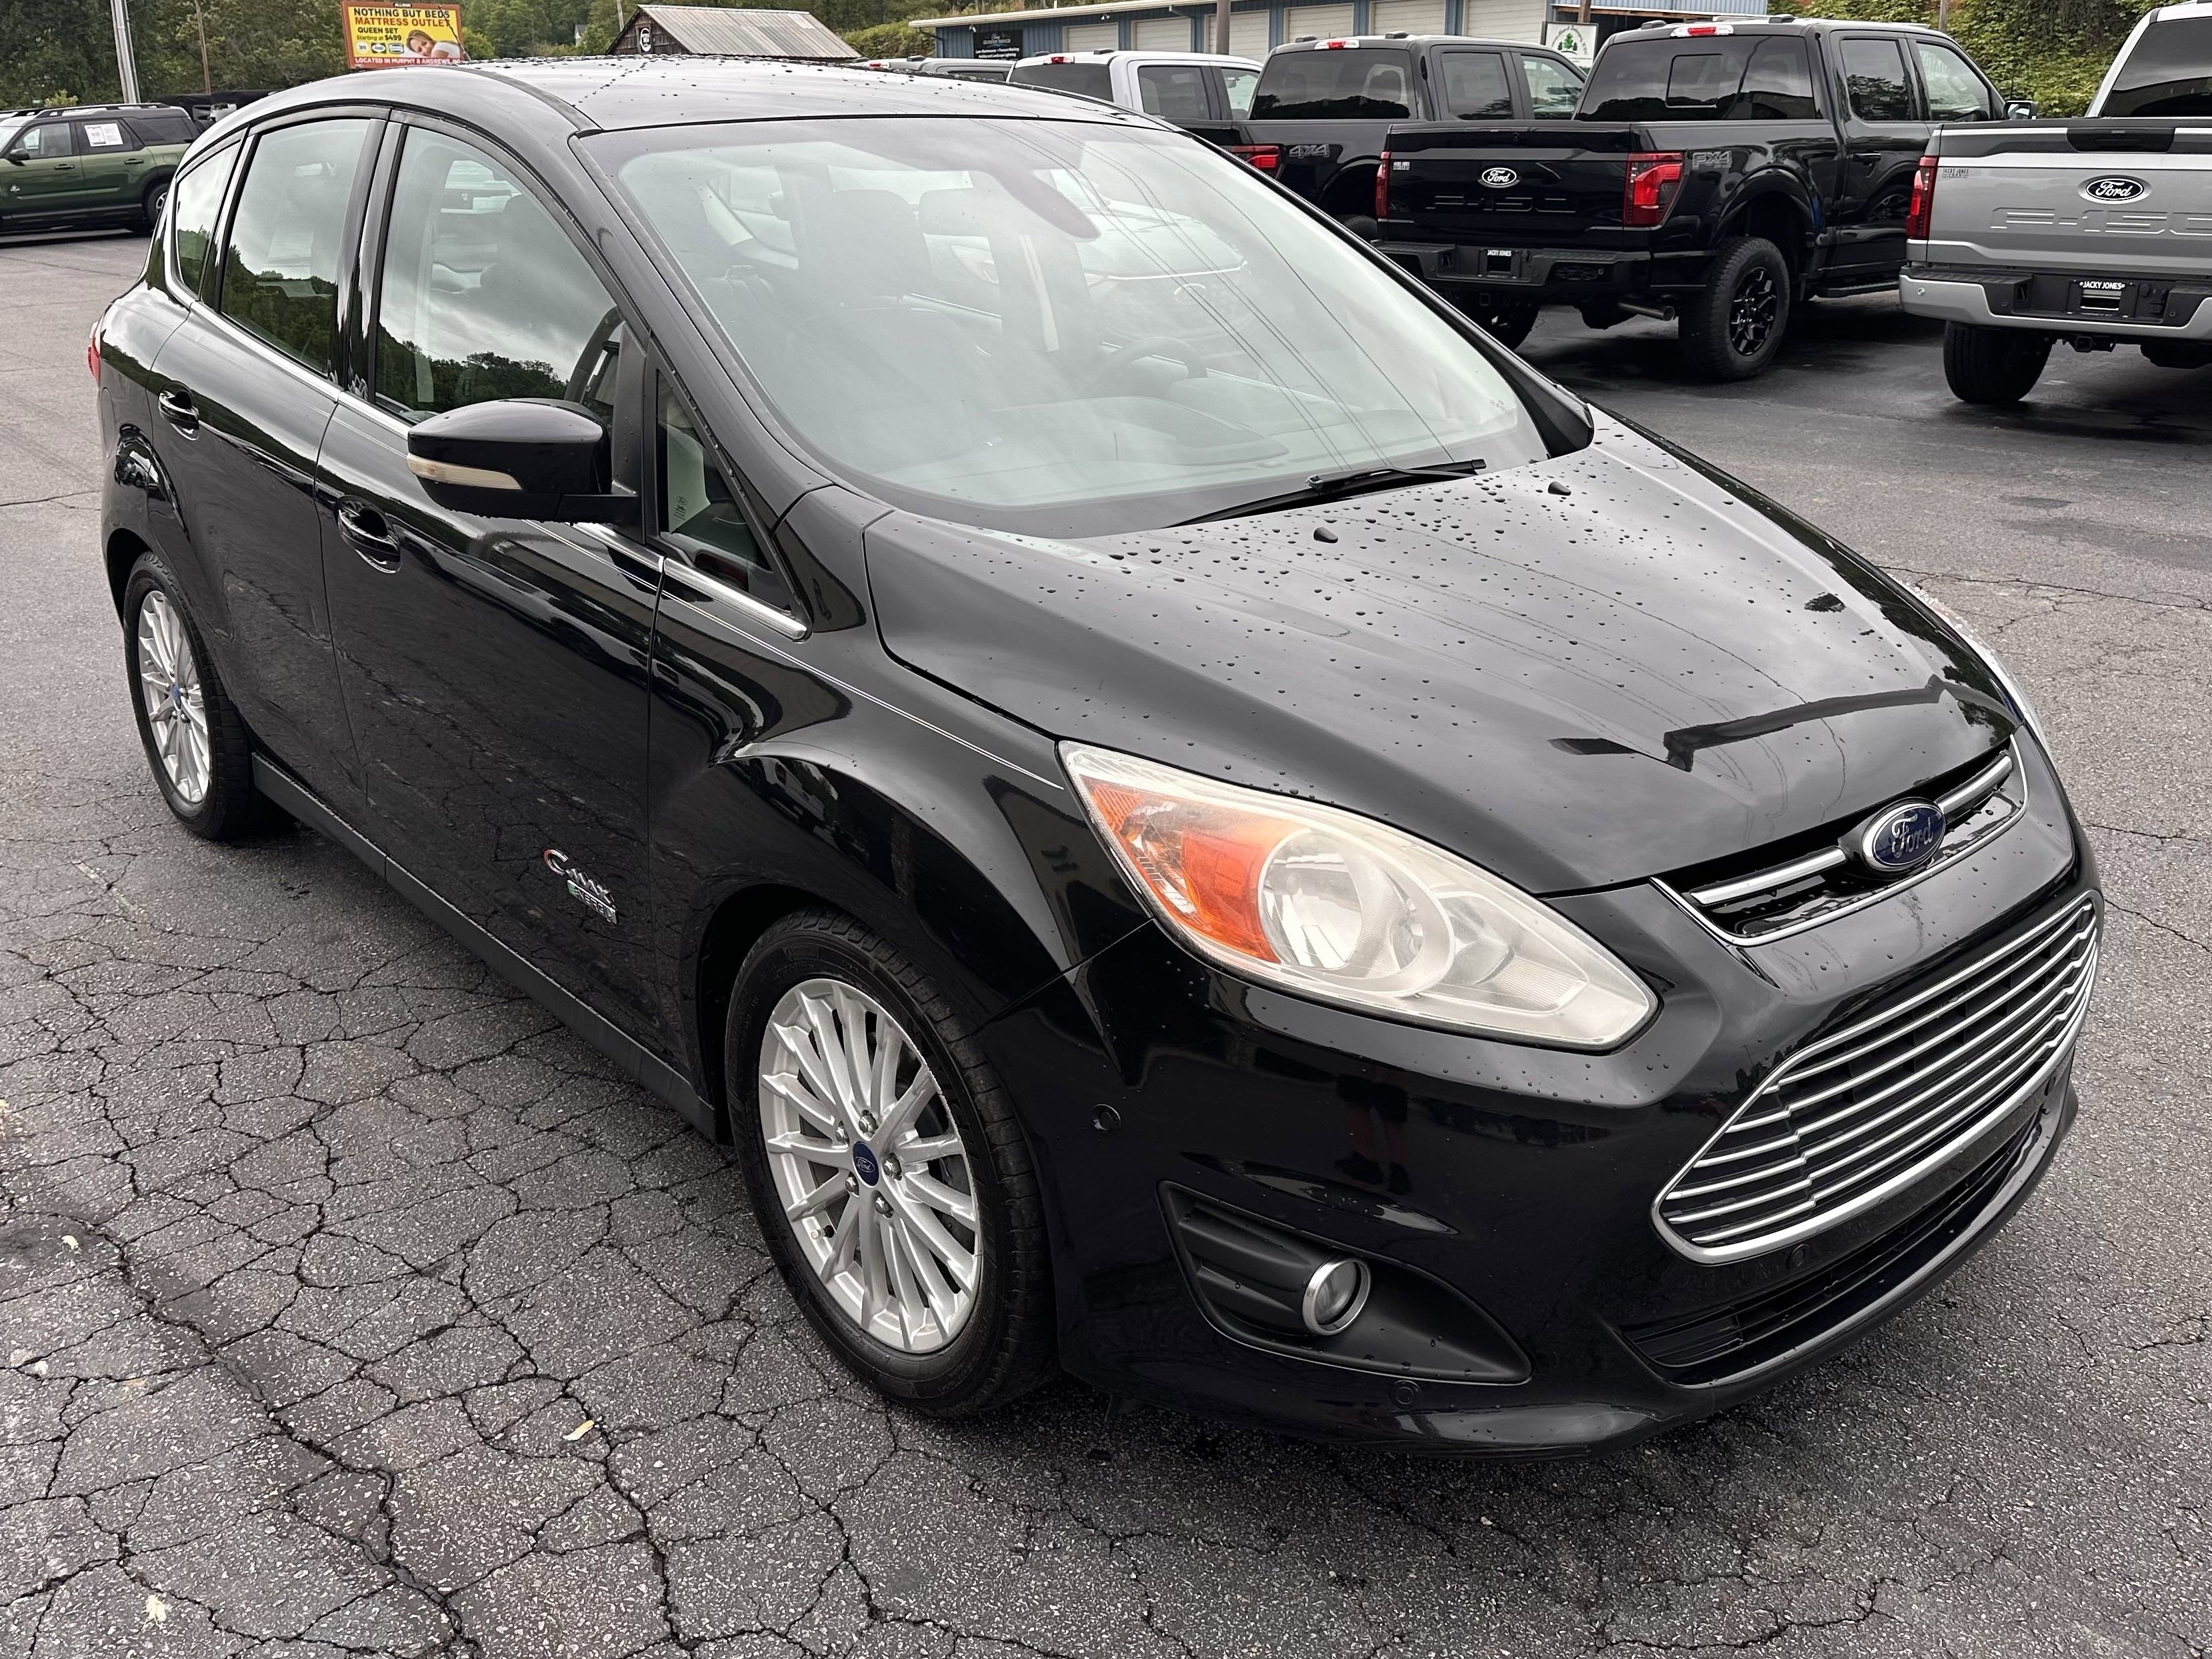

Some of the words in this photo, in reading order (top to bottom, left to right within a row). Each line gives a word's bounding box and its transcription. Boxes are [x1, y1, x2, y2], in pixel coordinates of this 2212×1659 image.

[354, 8, 399, 17] NOTHING
[402, 9, 421, 18] BUT
[425, 10, 450, 18] BEDS
[355, 17, 409, 26] MATTRESS
[411, 19, 450, 27] OUTLET
[1693, 151, 1732, 169] FX4
[1487, 169, 1511, 182] Ford
[2095, 181, 2133, 197] Ford
[2083, 281, 2102, 289] JACKY
[2102, 281, 2122, 290] JONES
[1891, 812, 1933, 859] Ford
[857, 1158, 872, 1171] Ford
